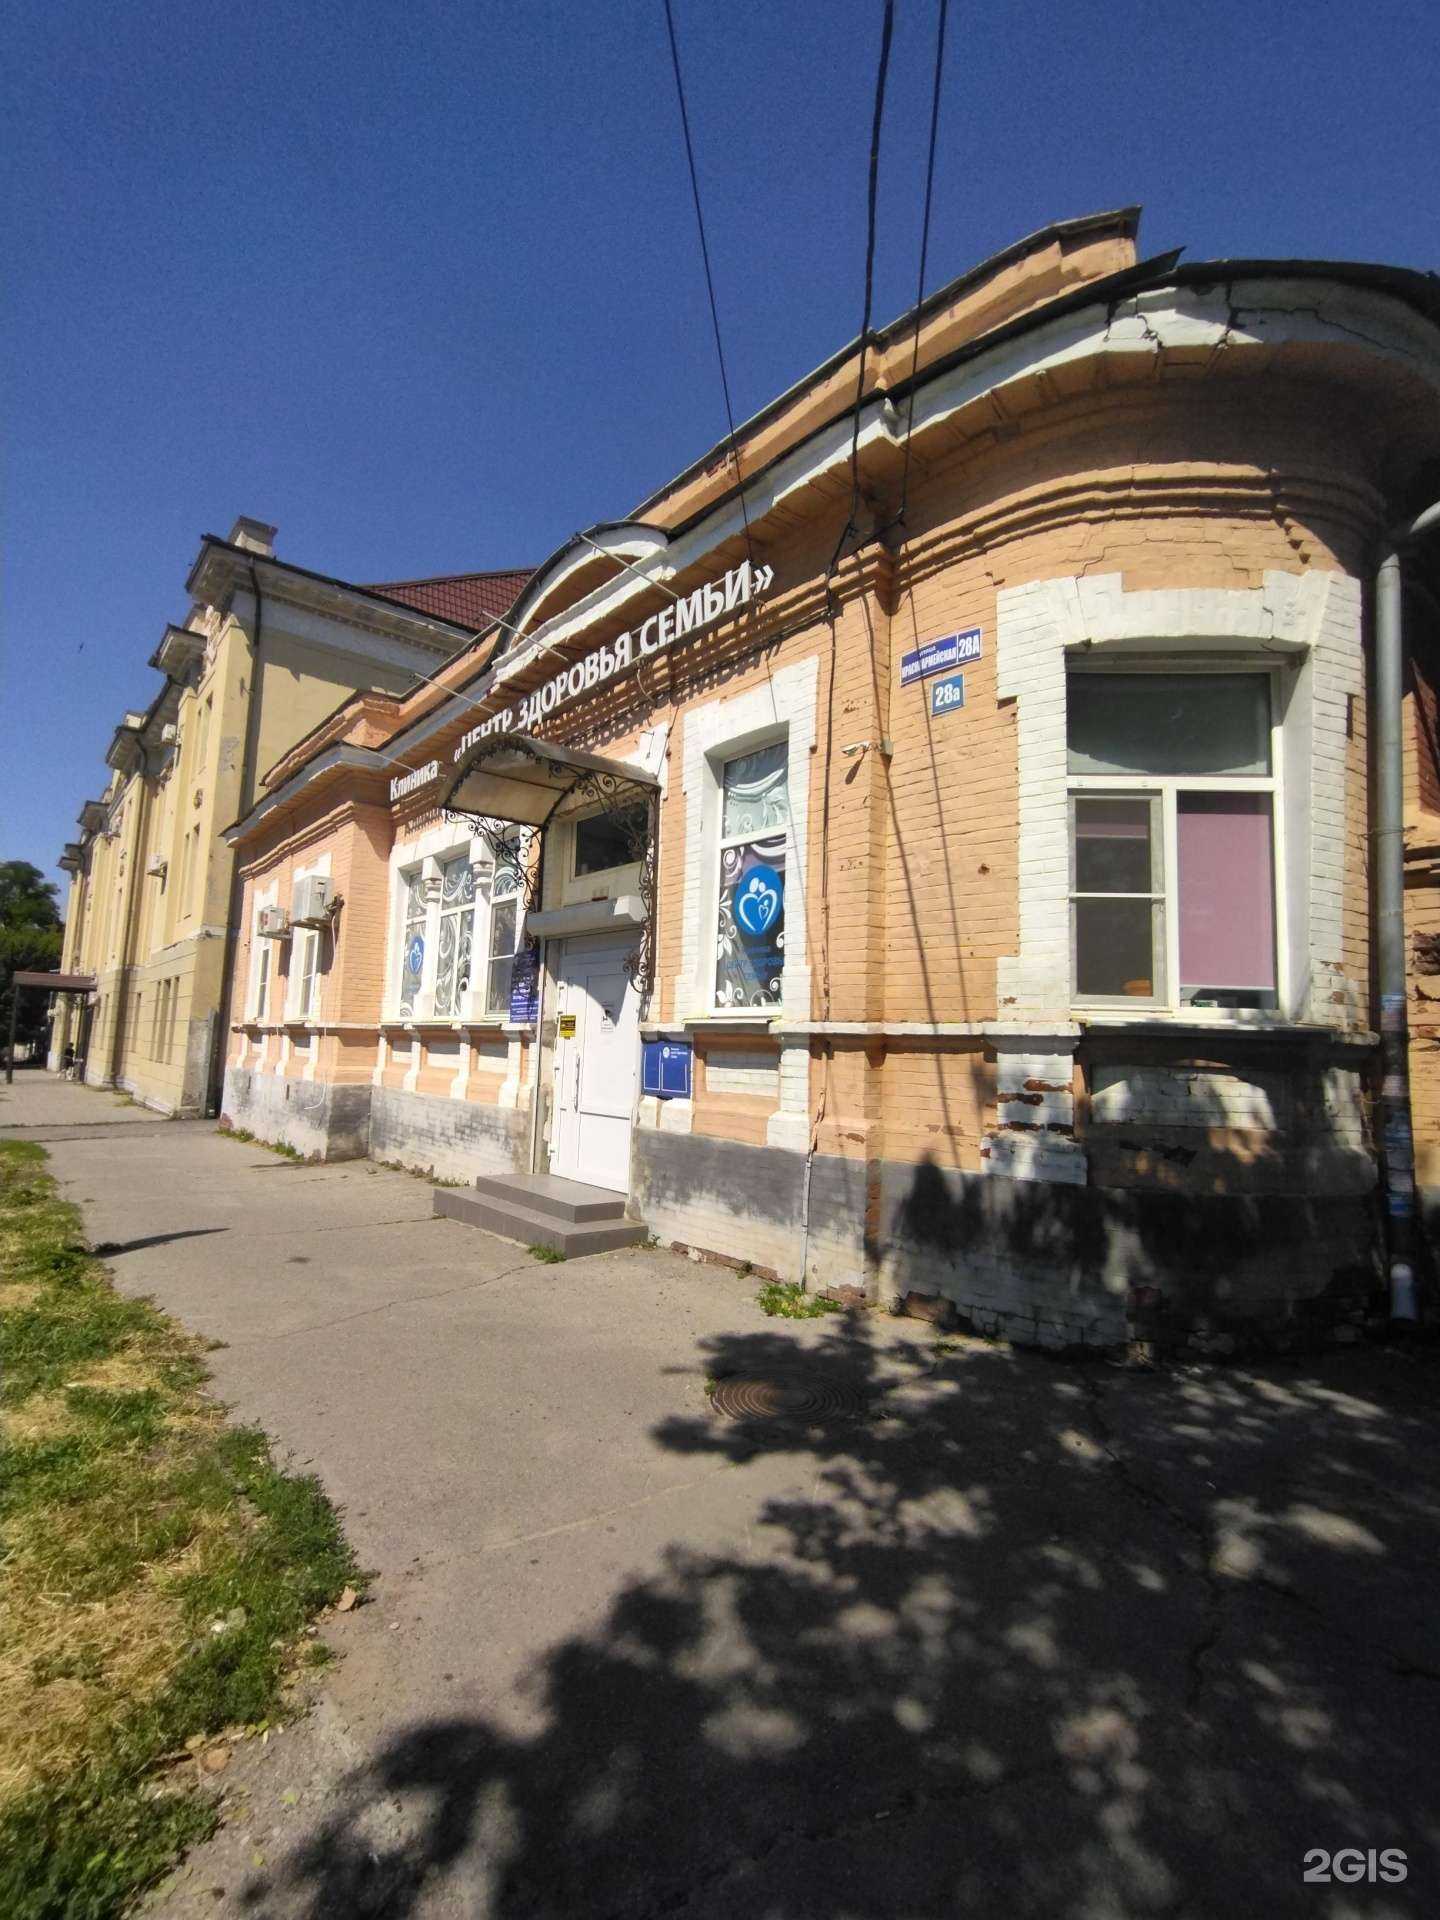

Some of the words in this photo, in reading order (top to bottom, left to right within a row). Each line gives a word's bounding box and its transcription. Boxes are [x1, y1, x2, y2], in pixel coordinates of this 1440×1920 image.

[390, 760, 440, 801] Клиника
[518, 631, 632, 731] ЗДОРОВЬЯ
[640, 559, 774, 655] СЕМЬИ»
